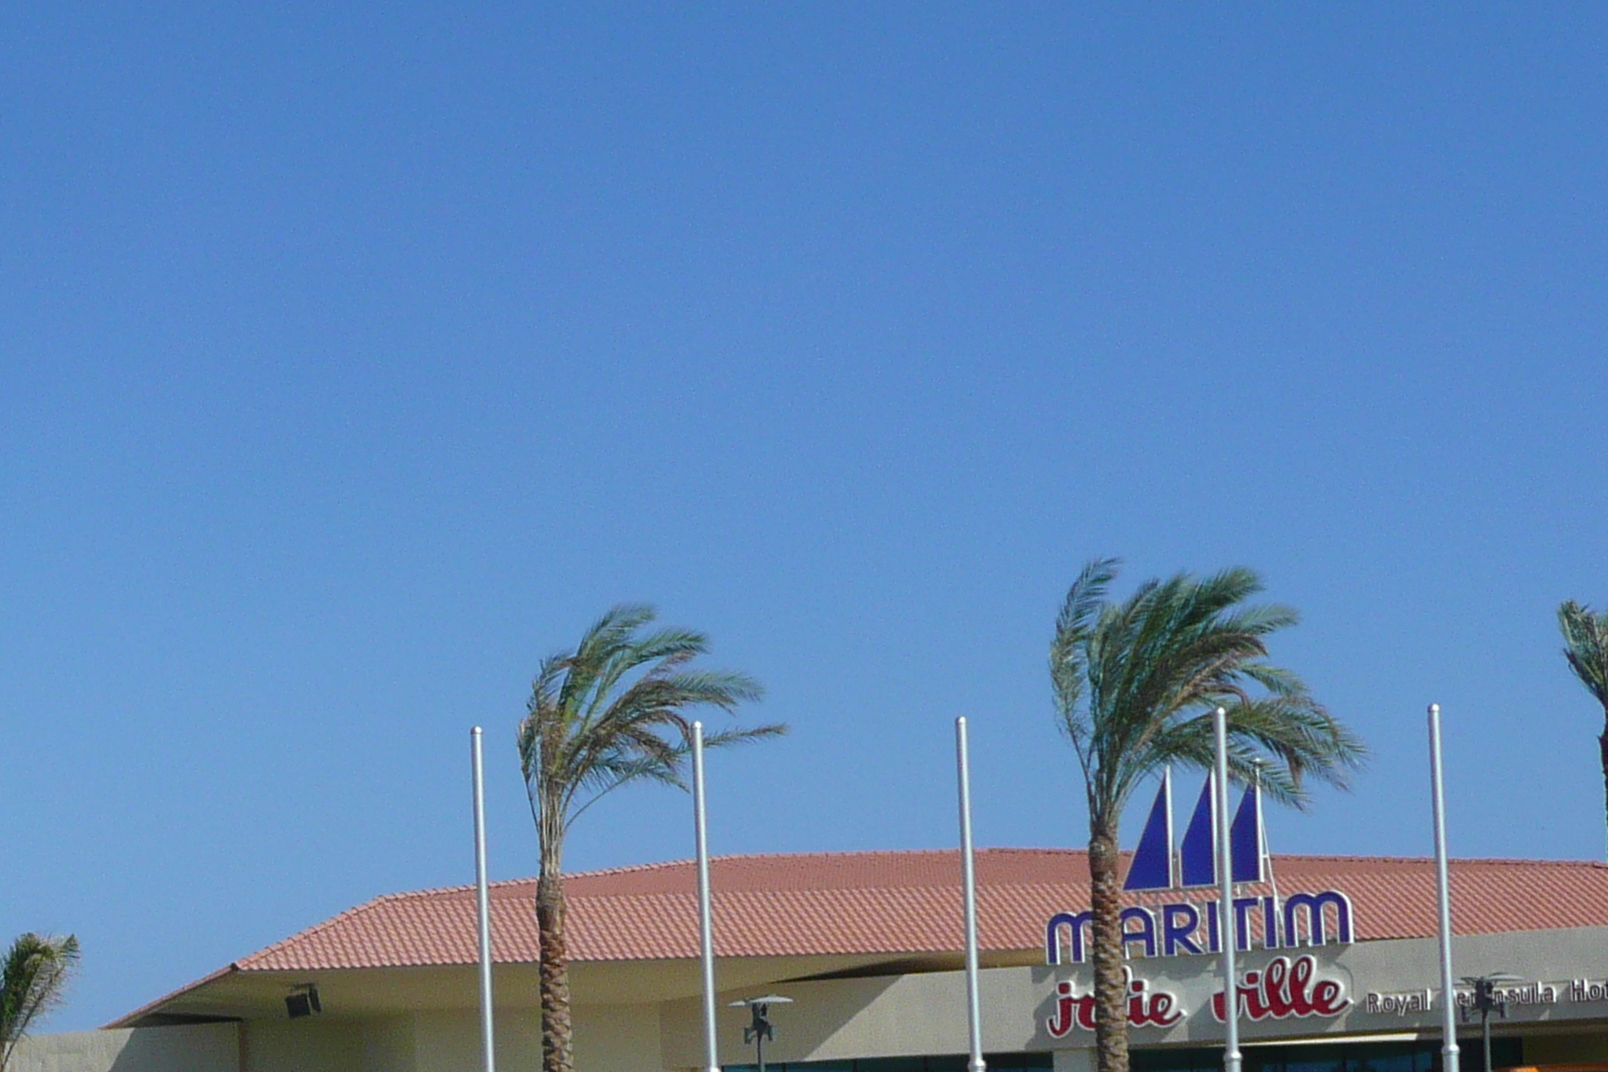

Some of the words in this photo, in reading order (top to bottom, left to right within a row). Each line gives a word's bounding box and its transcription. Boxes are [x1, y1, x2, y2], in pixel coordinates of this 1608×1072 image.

[1046, 889, 1355, 965] MARITIM
[1211, 954, 1355, 1023] ville
[1366, 989, 1432, 1017] Royal
